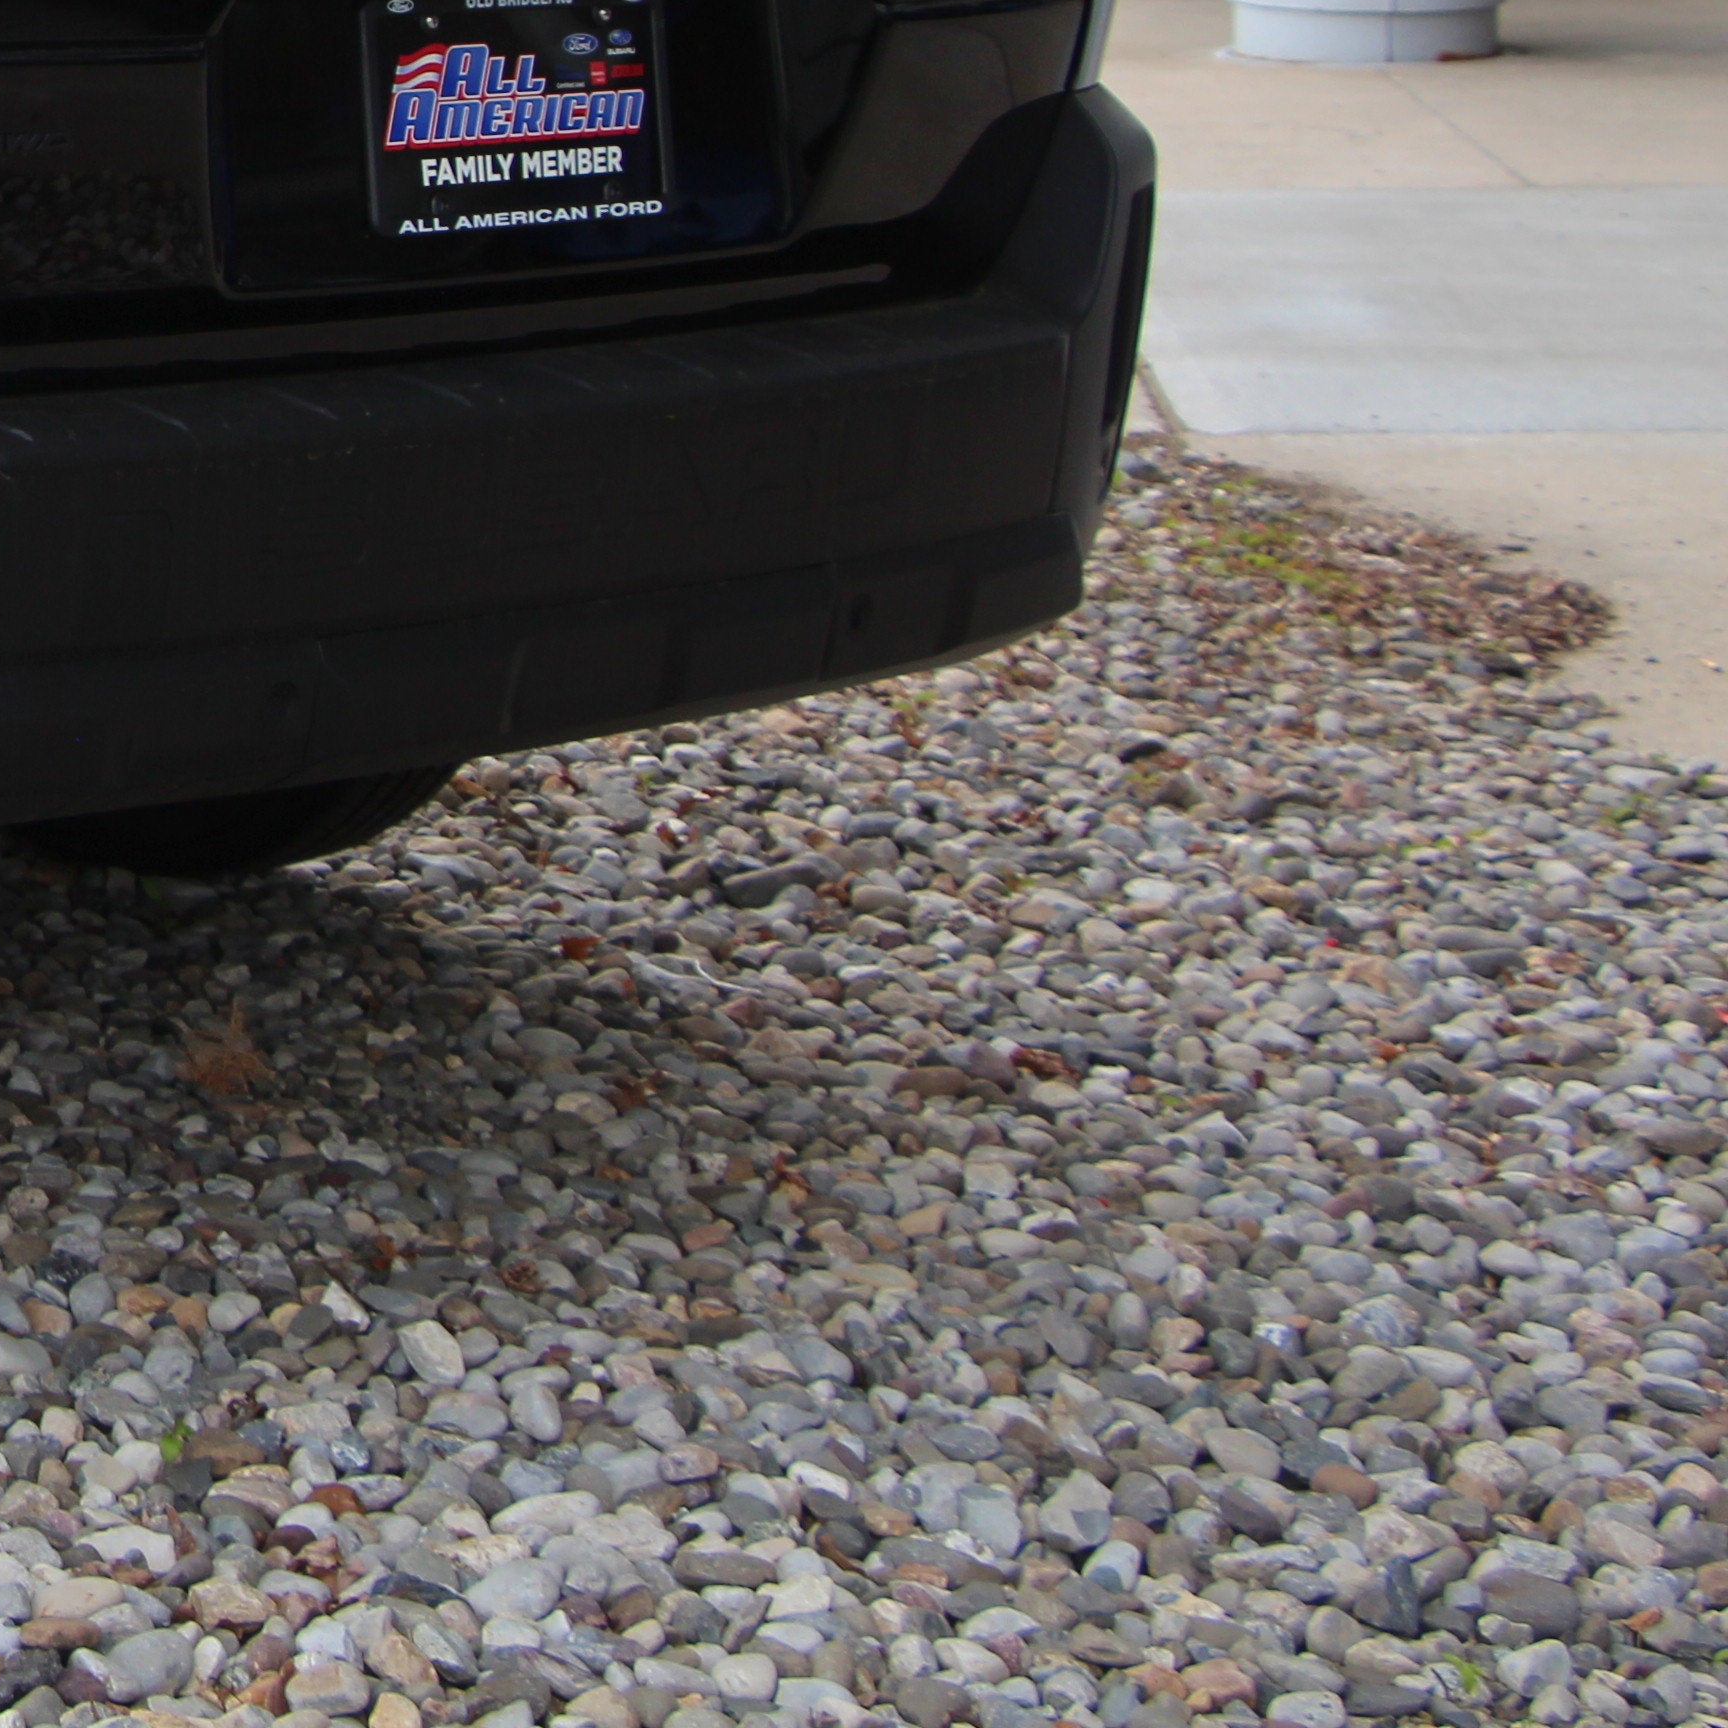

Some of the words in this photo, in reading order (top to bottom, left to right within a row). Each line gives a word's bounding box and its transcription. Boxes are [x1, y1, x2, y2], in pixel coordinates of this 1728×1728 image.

[566, 34, 595, 53] Ford
[421, 153, 515, 186] FAMILY
[522, 145, 623, 180] MEMBER
[398, 218, 449, 235] ALL
[454, 205, 589, 230] AMERICAN
[594, 199, 664, 219] FORD
